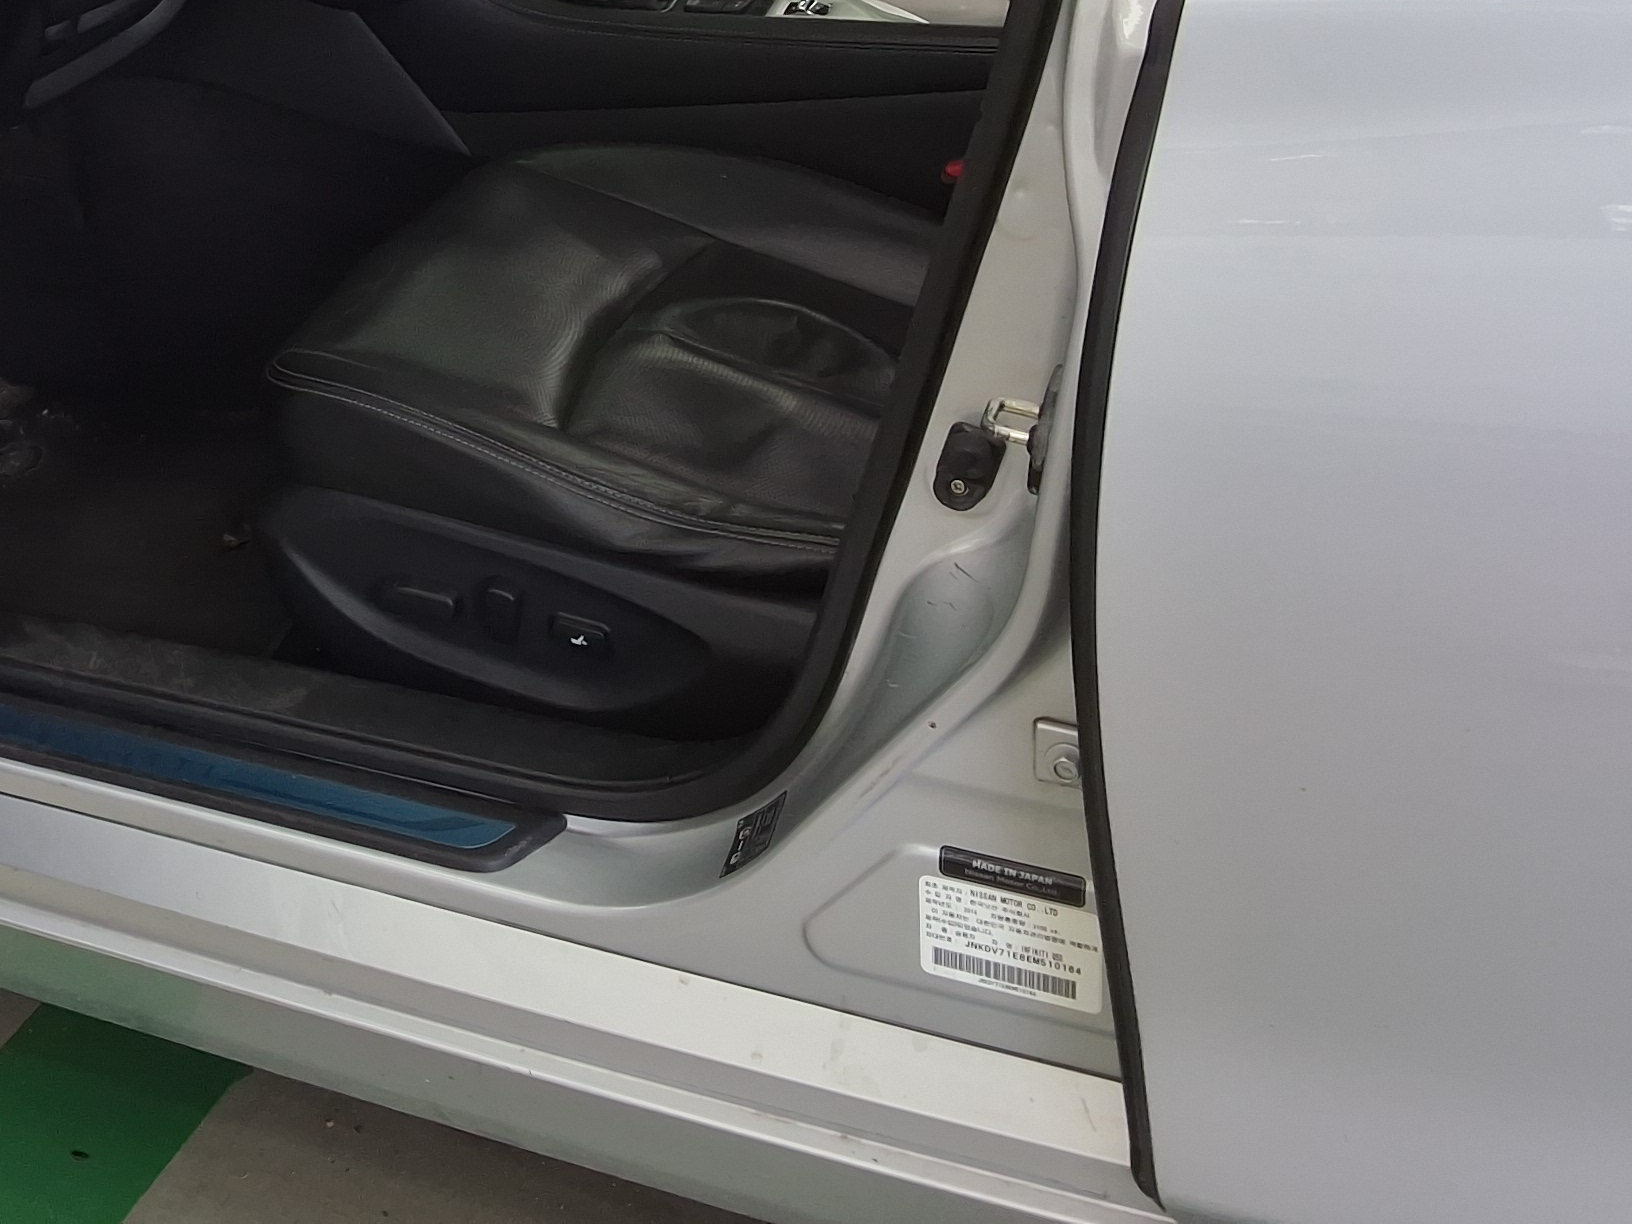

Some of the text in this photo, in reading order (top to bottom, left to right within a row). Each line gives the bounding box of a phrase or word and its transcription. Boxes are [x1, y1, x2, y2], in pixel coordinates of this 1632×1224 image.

[972, 859, 1053, 886] MADE IN JAPAN
[970, 889, 997, 902] NISSAN
[1000, 895, 1022, 908] MOTOR
